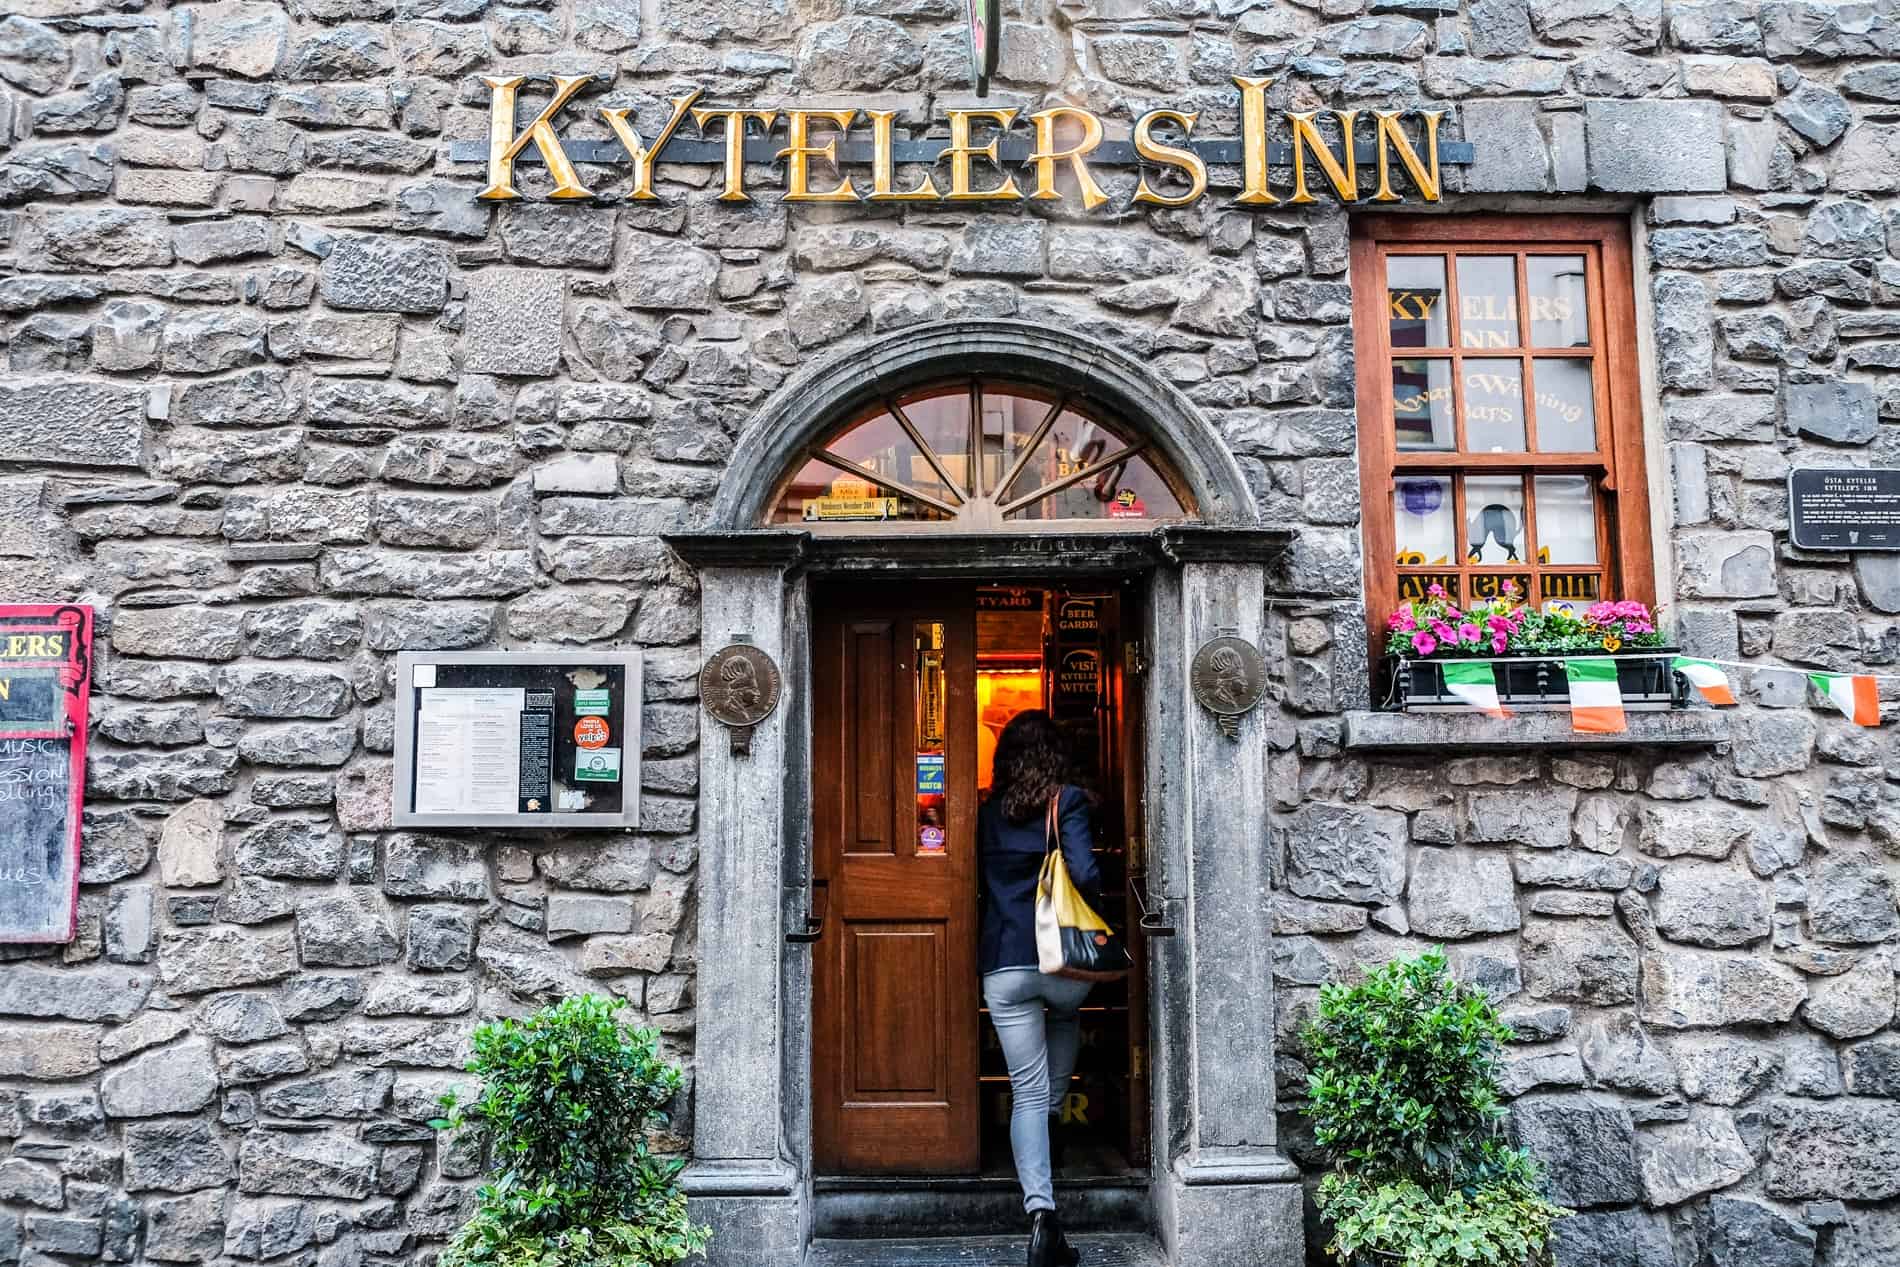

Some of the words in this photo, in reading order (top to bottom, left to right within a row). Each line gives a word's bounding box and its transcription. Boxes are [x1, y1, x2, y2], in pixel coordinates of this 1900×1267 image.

[475, 74, 1207, 210] KYTELERS
[1231, 76, 1453, 205] INN
[1390, 290, 1574, 322] KYELRS
[1463, 328, 1511, 349] NN
[1067, 609, 1096, 619] BEER
[1059, 620, 1098, 630] GARDE
